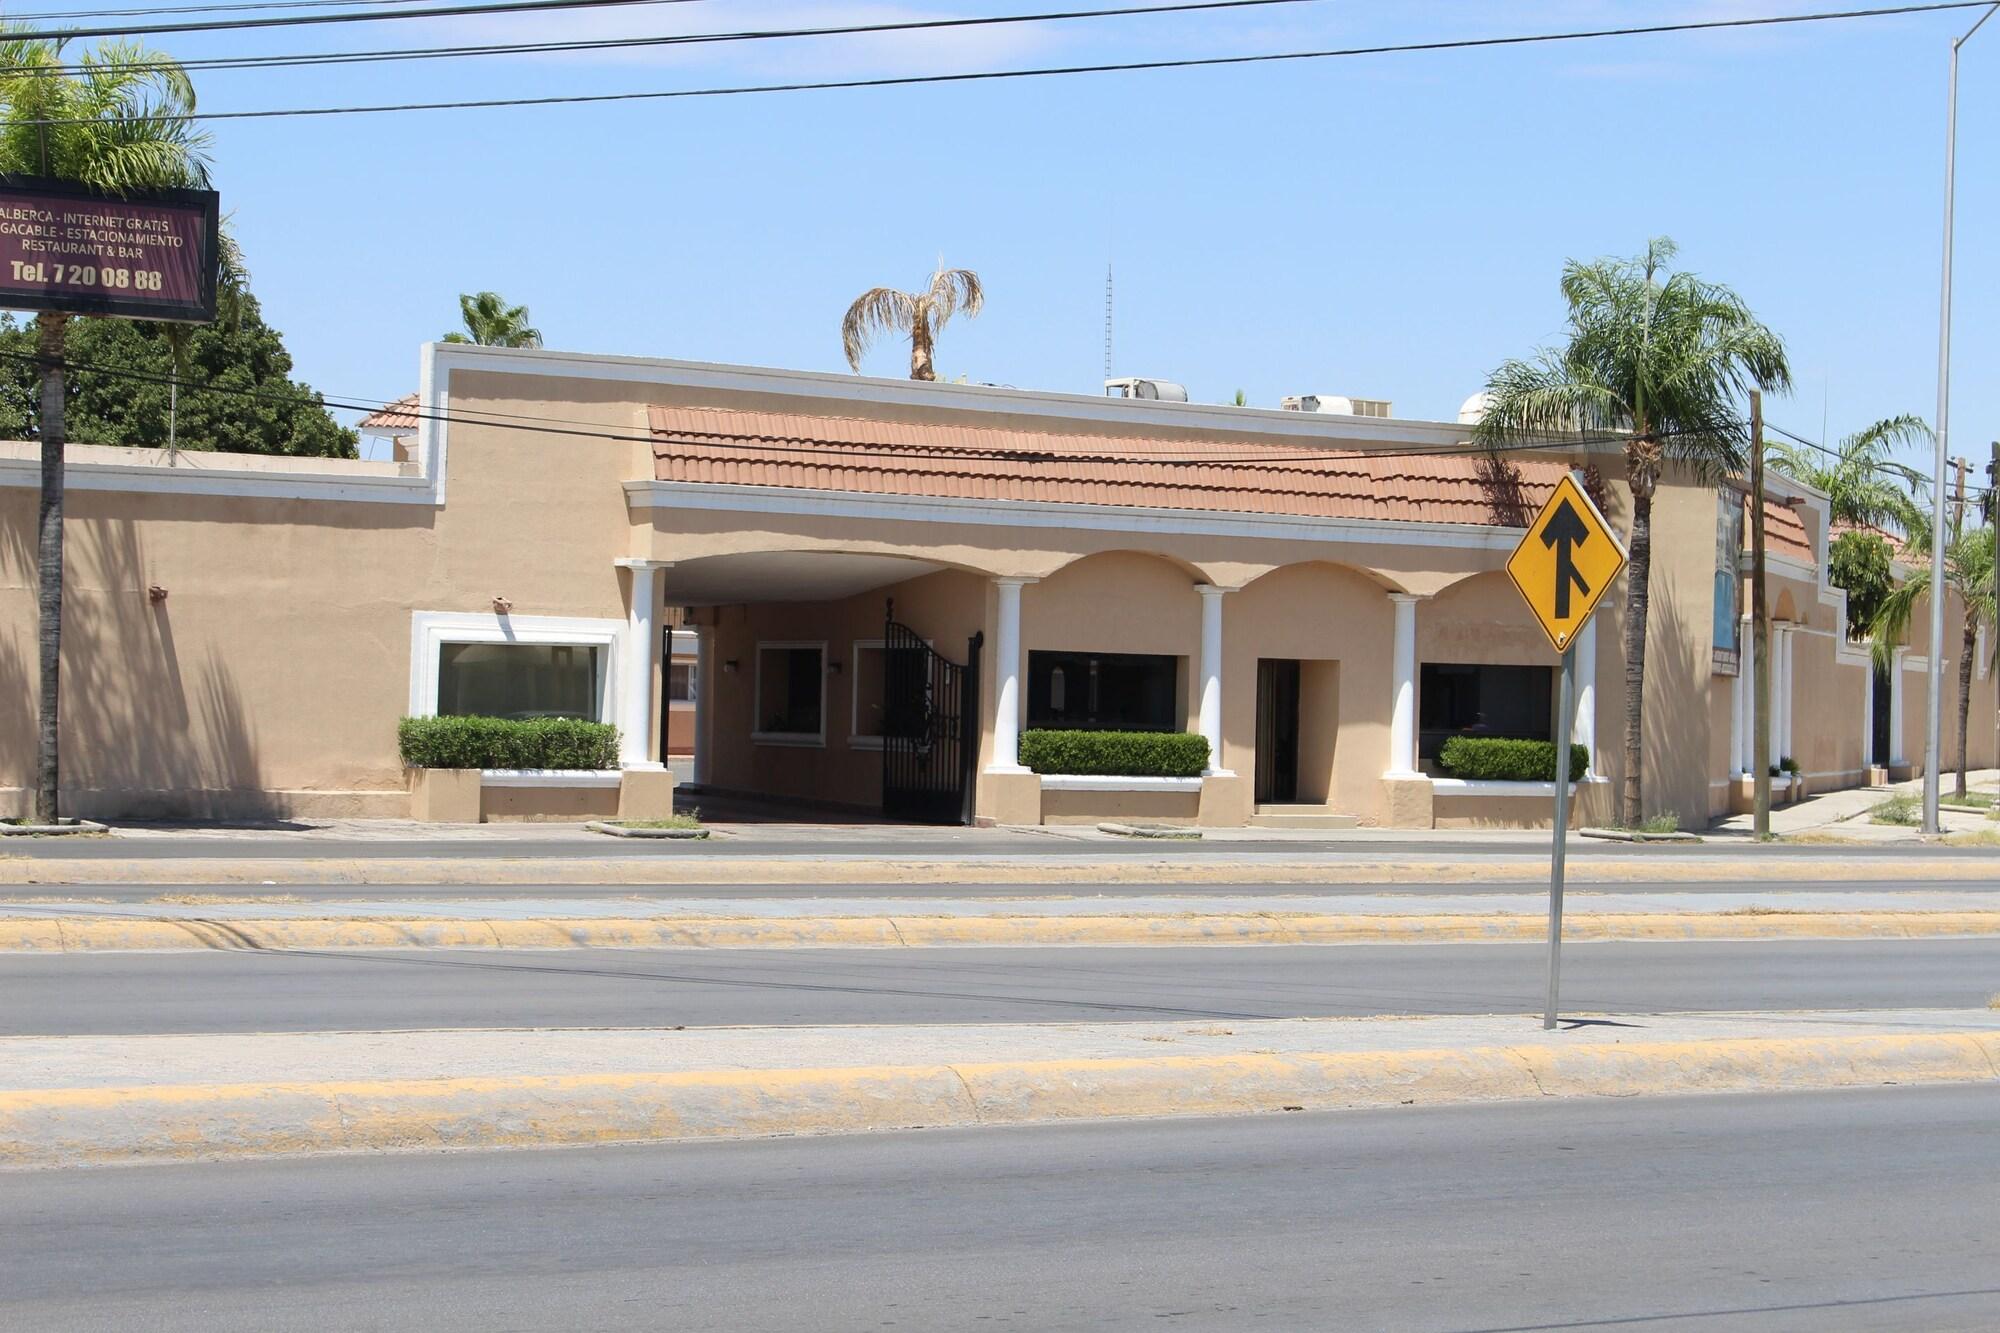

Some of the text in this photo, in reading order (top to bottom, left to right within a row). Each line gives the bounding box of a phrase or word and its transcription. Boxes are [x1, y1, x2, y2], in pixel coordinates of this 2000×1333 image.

[0, 207, 53, 222] ALBERCA
[64, 212, 124, 227] INTERNET
[126, 218, 169, 232] GRATIS
[0, 222, 57, 237] GACABLE
[67, 229, 183, 248] ESTACIONAMIENTO
[22, 239, 143, 259] RESTAURANT & BAR
[10, 260, 162, 291] Tel. 7 20 08 88
